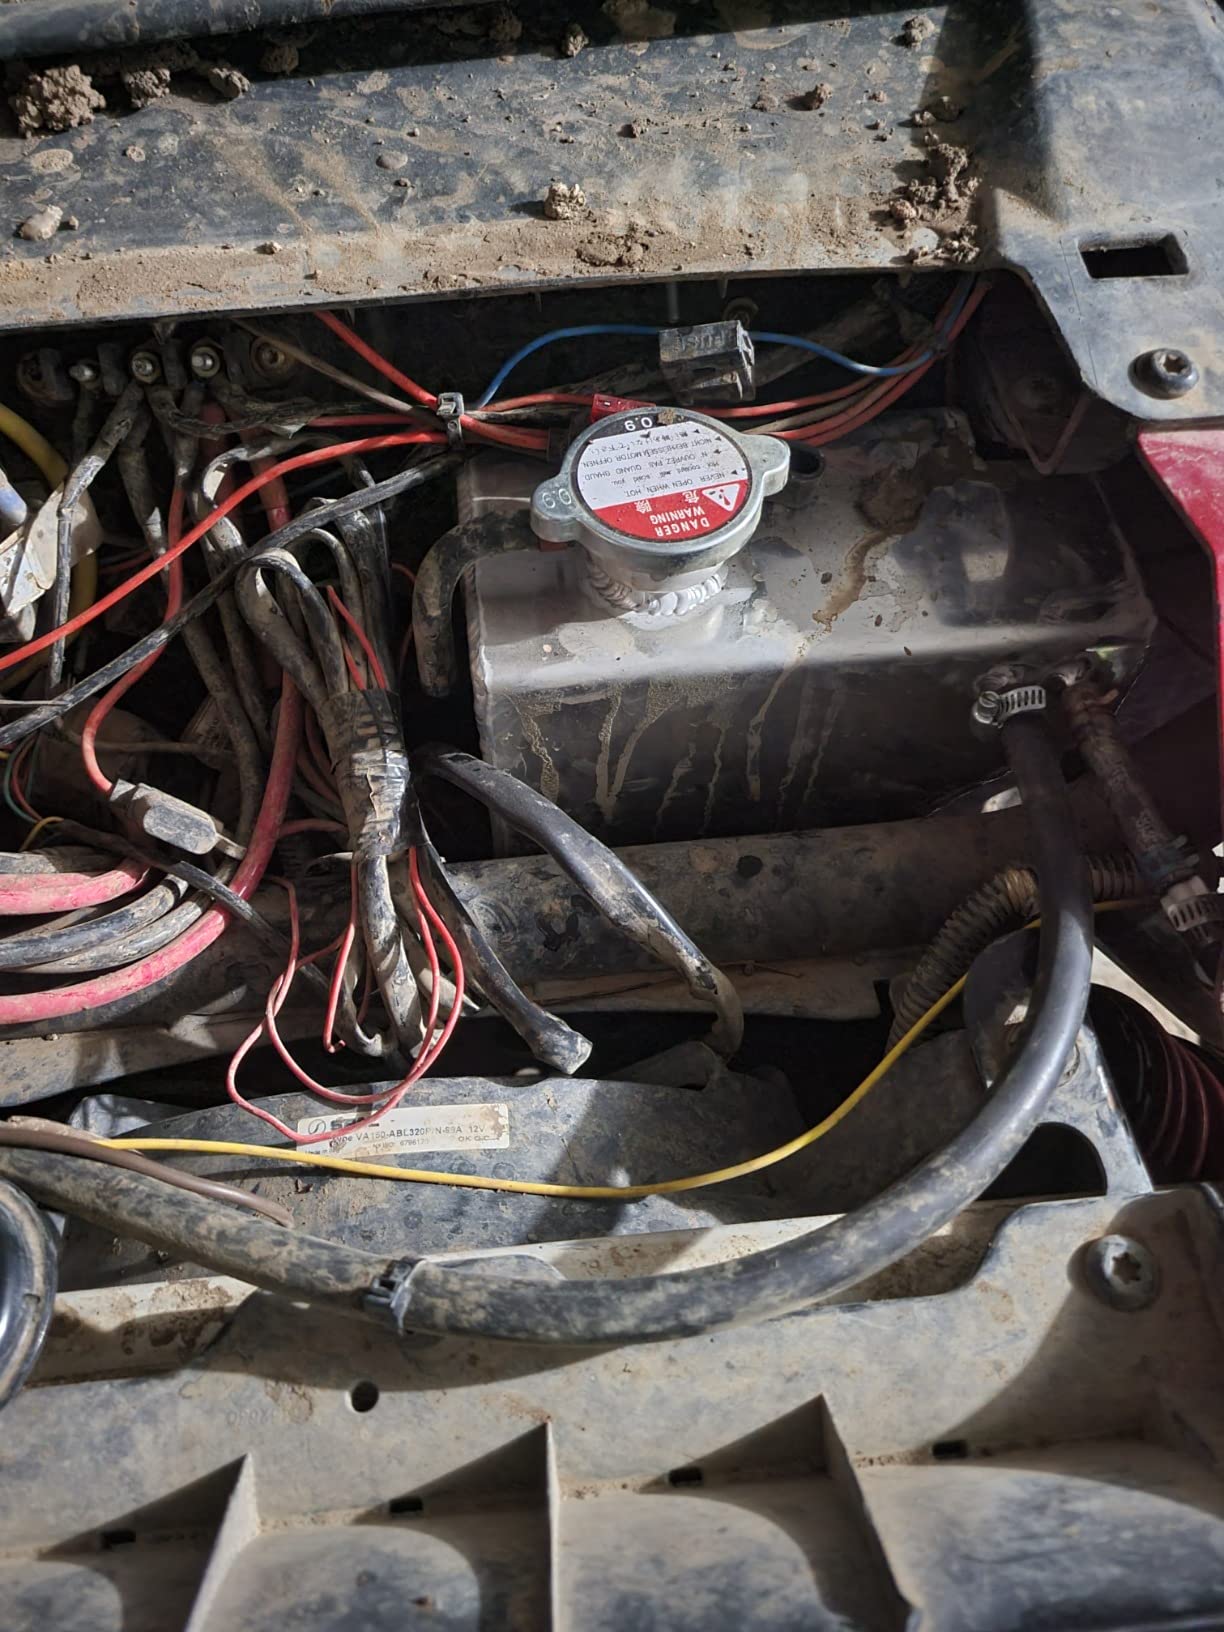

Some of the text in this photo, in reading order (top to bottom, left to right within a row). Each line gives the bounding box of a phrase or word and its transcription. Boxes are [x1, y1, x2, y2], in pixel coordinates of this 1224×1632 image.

[624, 417, 653, 431] 0.9
[691, 438, 712, 447] NICHT
[615, 452, 642, 462] MOTOR
[615, 464, 642, 474] QUAND
[648, 460, 663, 468] PAS
[700, 472, 725, 482] NEVER
[647, 484, 670, 493] WHEN
[672, 479, 693, 488] OPEN
[542, 488, 572, 508] 0.9
[650, 506, 705, 525] WARNING
[655, 518, 710, 537] DANGER
